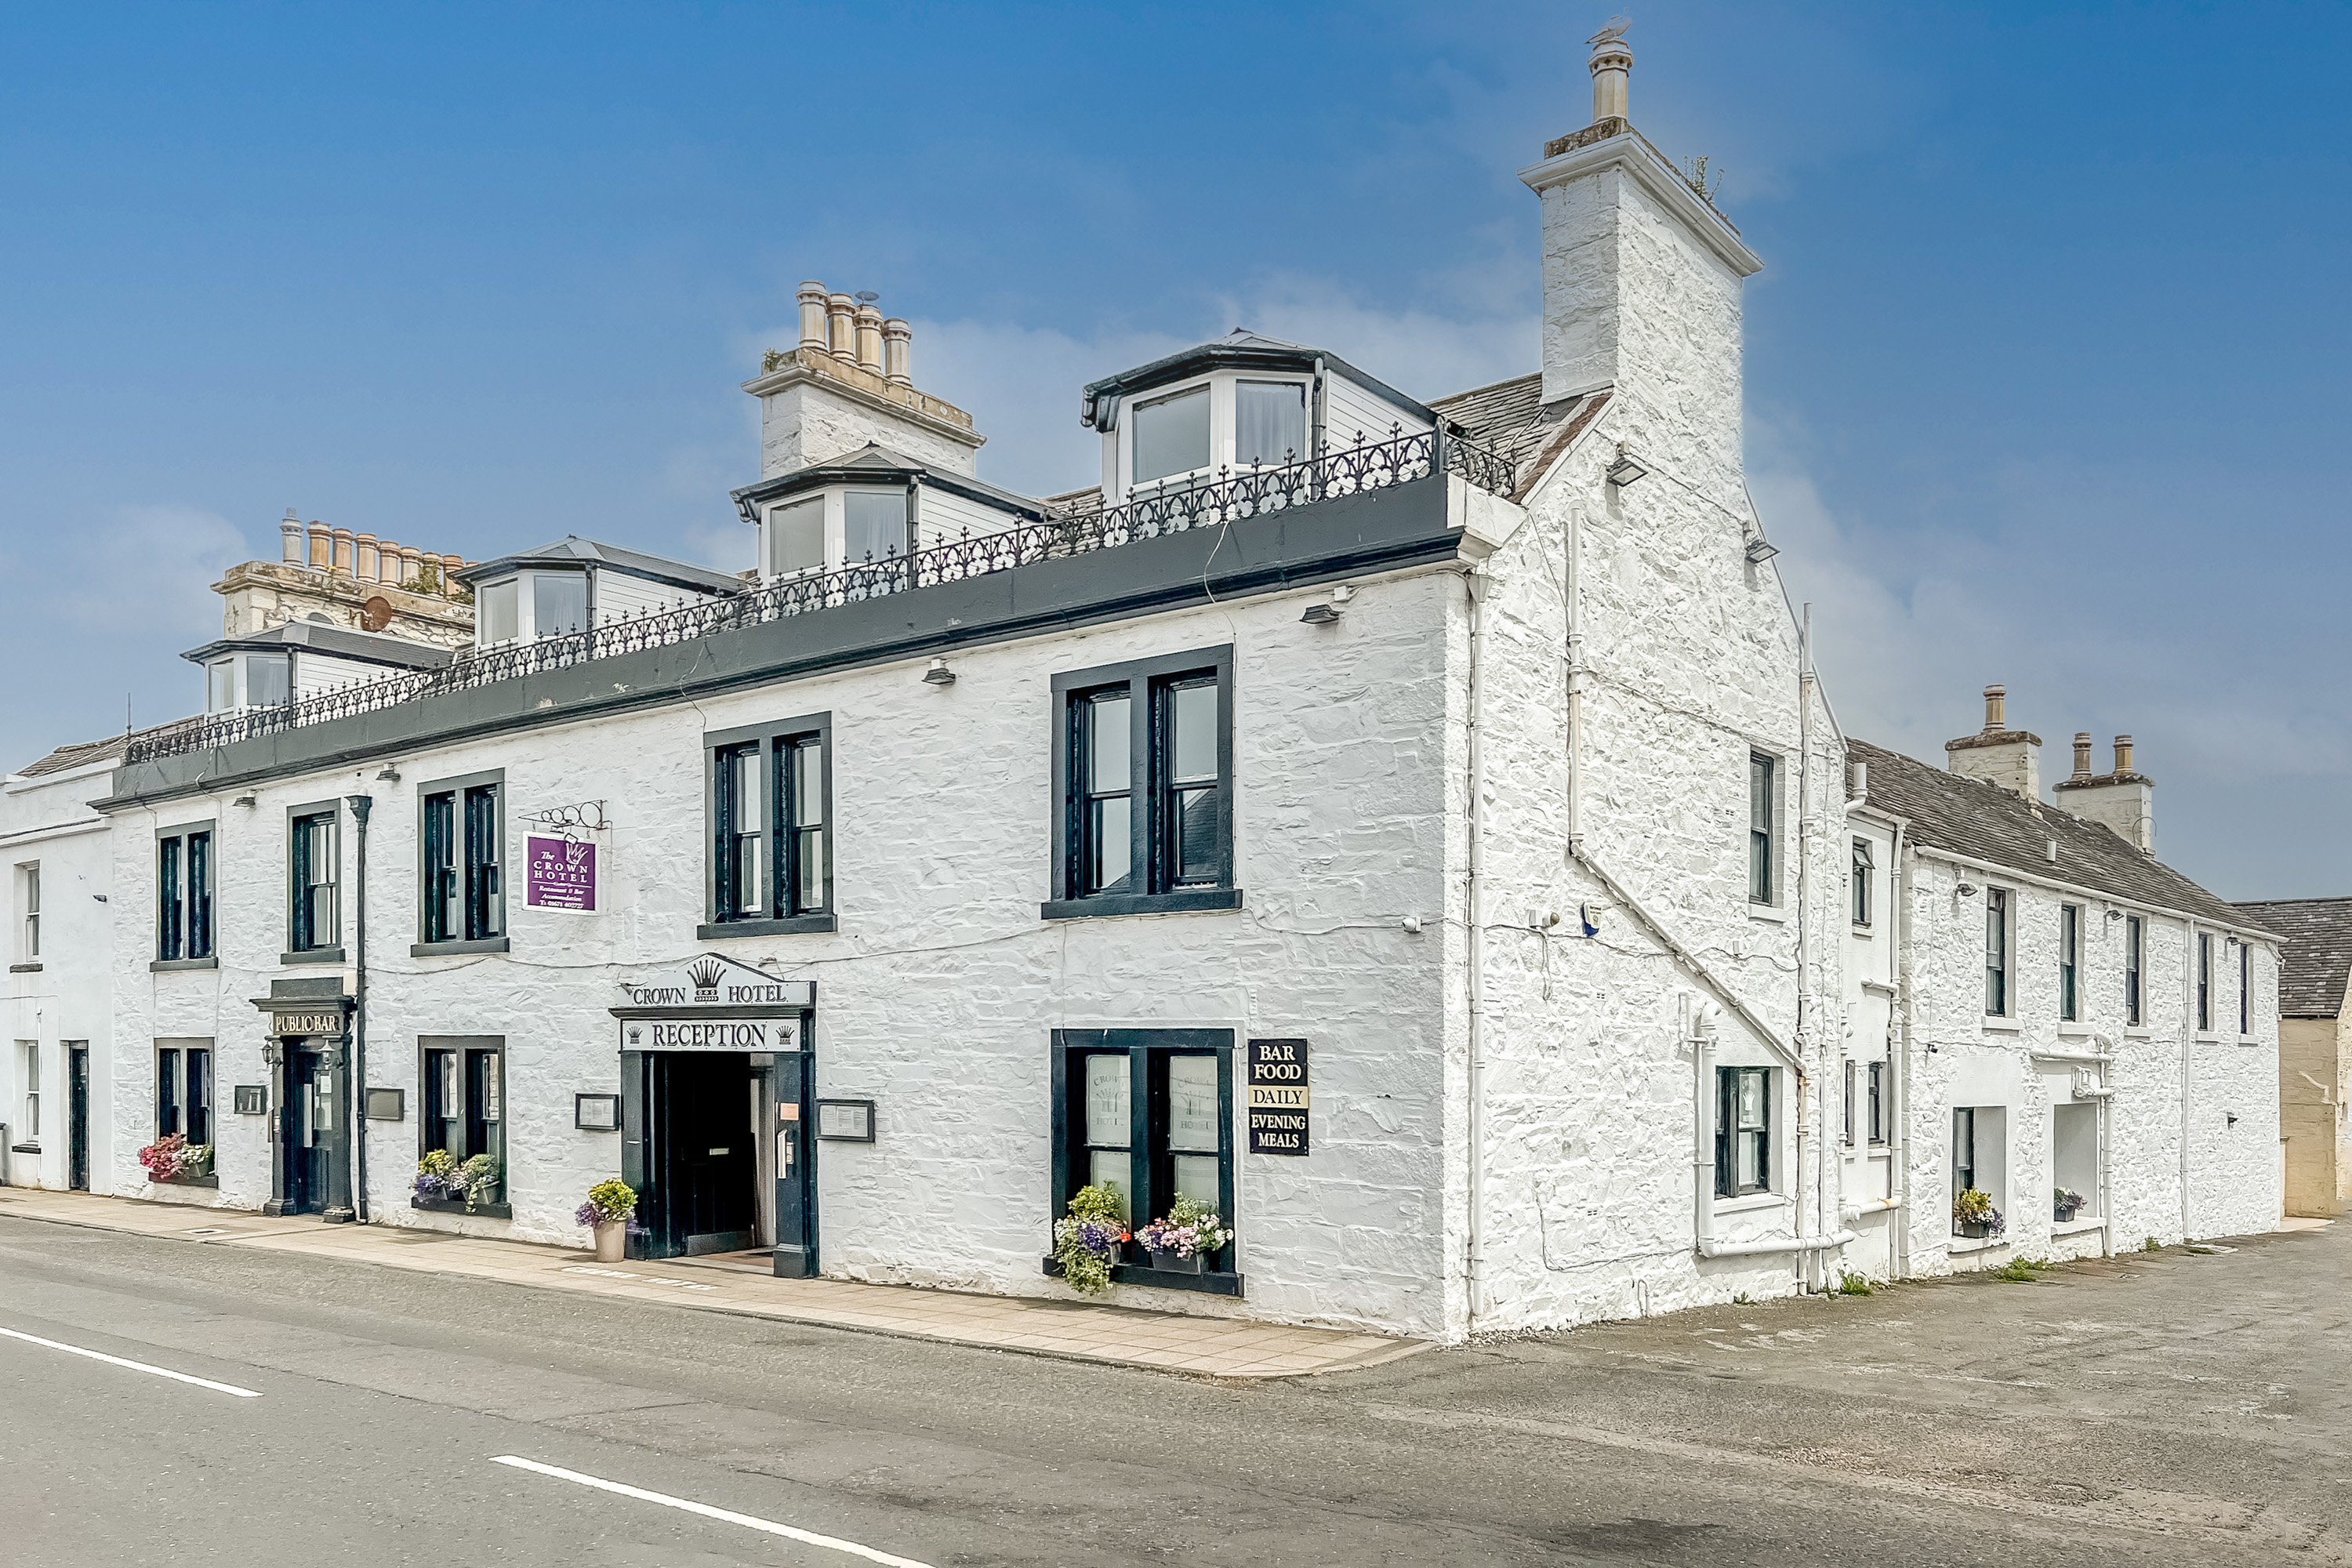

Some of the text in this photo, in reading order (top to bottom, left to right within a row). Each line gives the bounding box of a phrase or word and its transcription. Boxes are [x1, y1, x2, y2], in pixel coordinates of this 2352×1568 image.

[541, 851, 555, 860] The
[533, 860, 588, 873] CROWN
[533, 869, 587, 883] HOTEL
[633, 984, 786, 1004] CROWN HOTEL
[275, 1015, 336, 1032] PUBLIC BAR
[652, 1024, 767, 1047] RECEPTION
[1258, 1045, 1295, 1061] BAR
[1254, 1064, 1301, 1080] FOOD
[1253, 1089, 1303, 1105] DAILY
[1250, 1114, 1306, 1130] EVENING
[1258, 1132, 1300, 1149] MEALS
